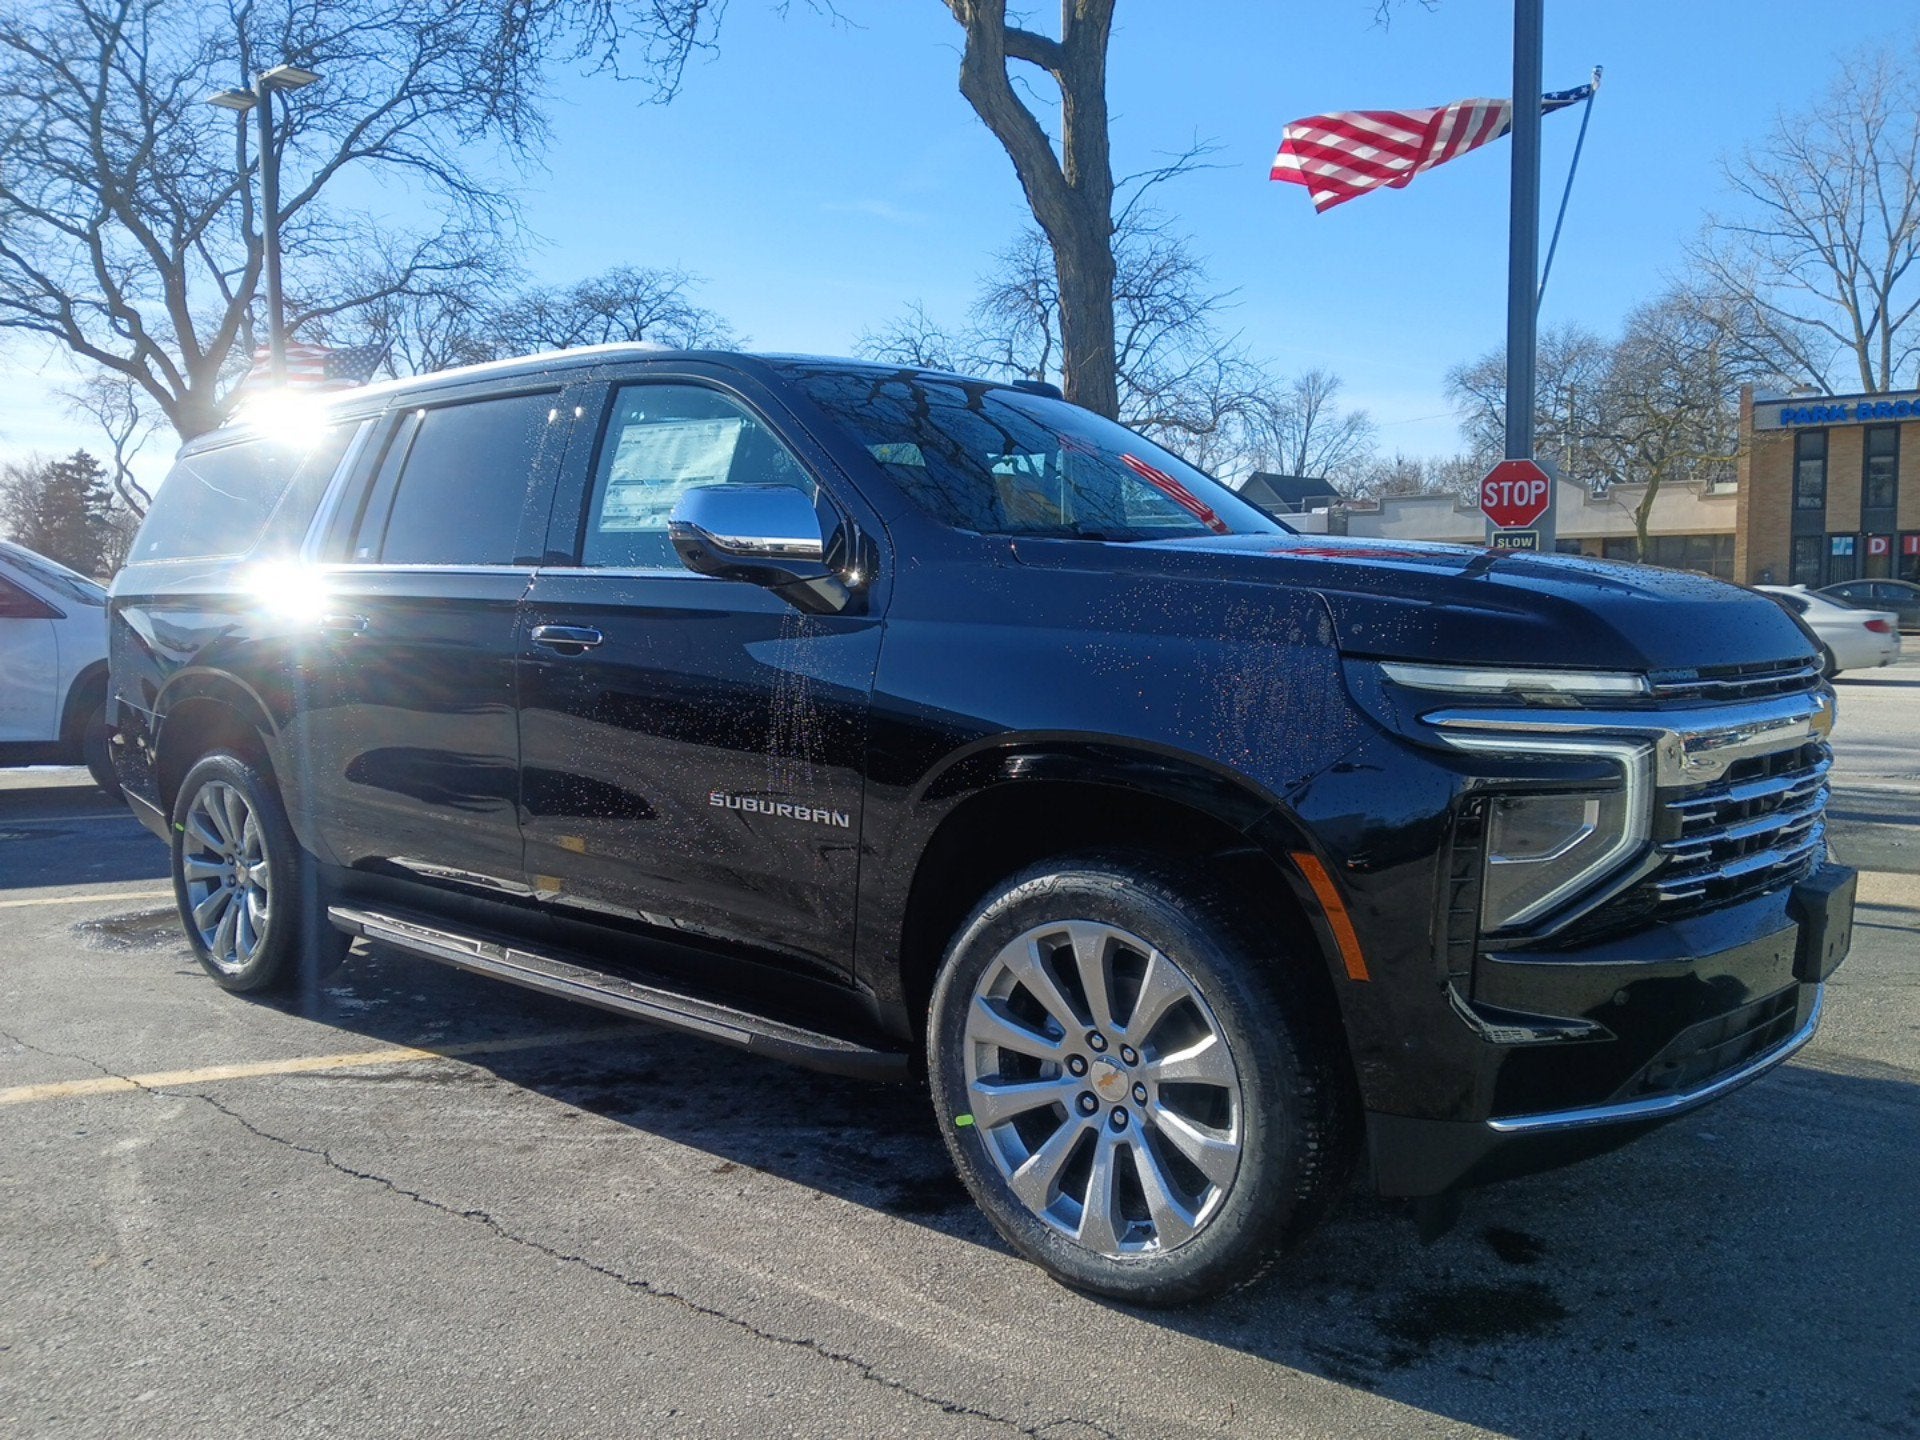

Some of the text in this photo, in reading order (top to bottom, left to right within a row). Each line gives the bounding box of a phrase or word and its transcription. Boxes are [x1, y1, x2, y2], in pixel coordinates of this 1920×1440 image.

[1780, 403, 1848, 425] PARK
[1483, 480, 1546, 507] STOP
[1498, 537, 1533, 548] SLOW
[710, 792, 849, 828] SUBURBAN
